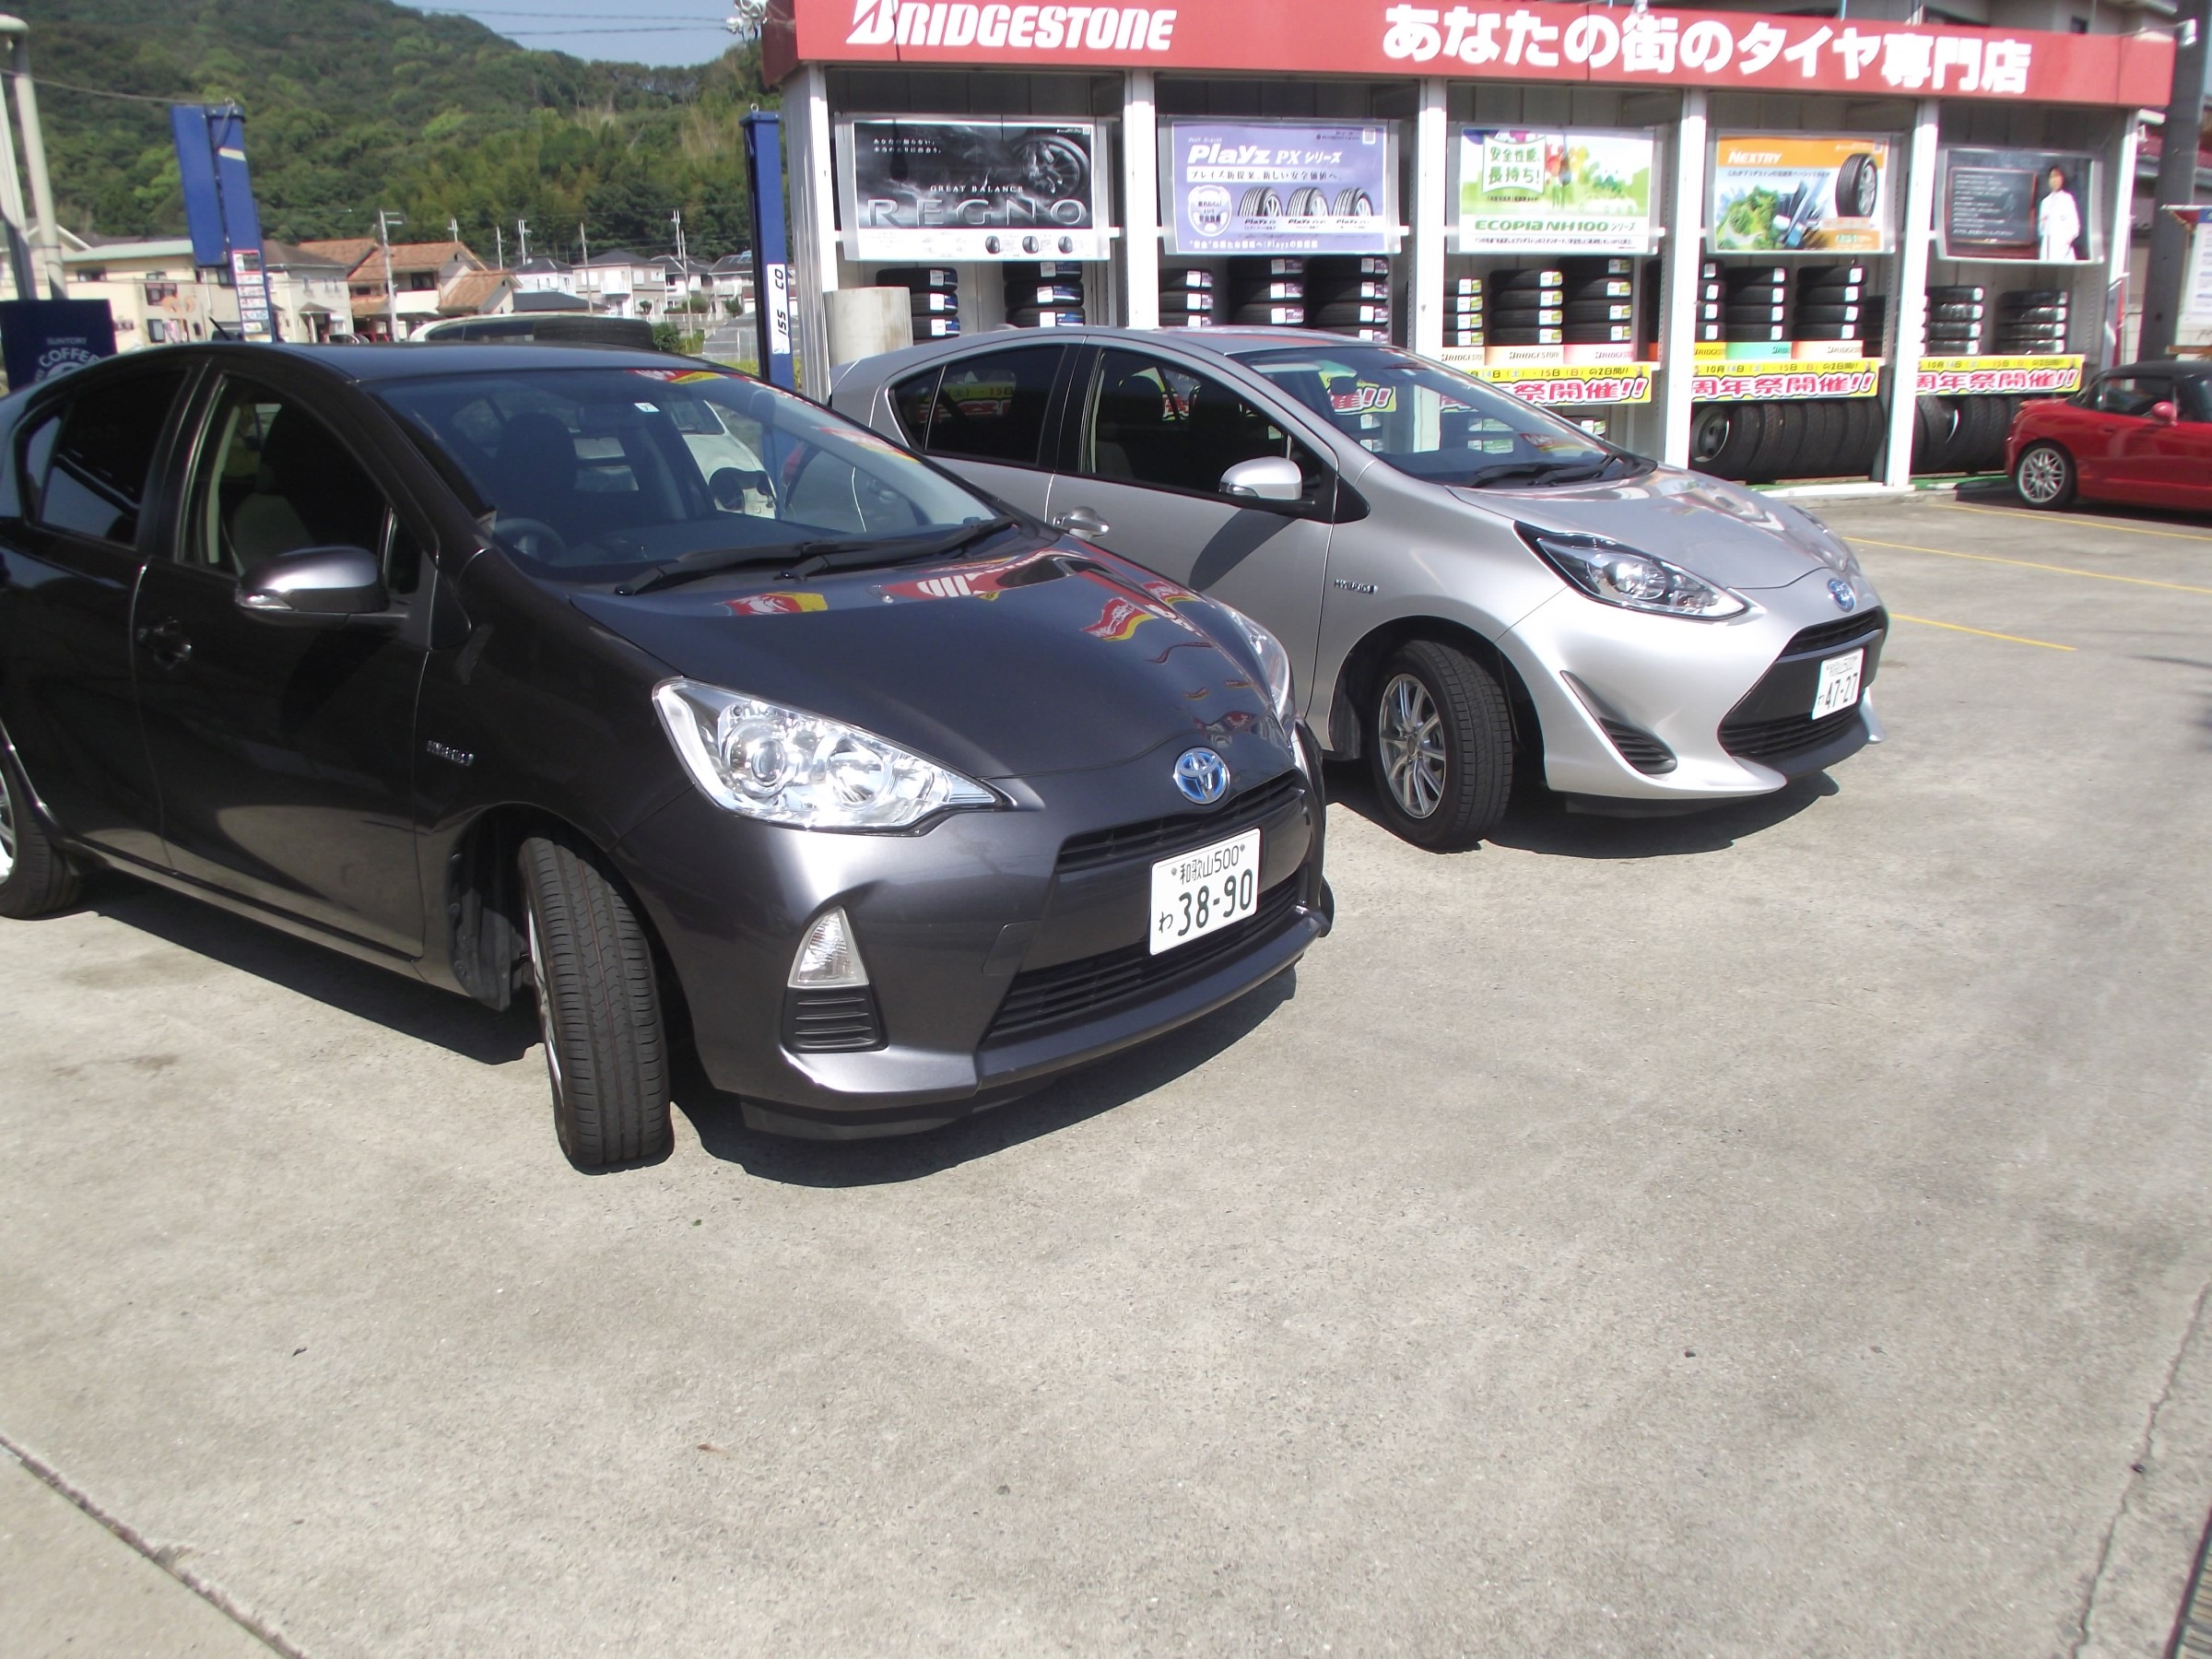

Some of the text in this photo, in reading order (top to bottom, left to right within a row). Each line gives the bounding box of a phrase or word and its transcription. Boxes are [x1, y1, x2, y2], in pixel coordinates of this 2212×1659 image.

[845, 0, 1177, 51] BRIDGESTONE
[1382, 3, 2032, 95] あなたの街のタイヤ専門店
[1276, 150, 1303, 166] PX
[1304, 151, 1343, 164] シリーズ
[1727, 151, 1783, 164] NEXTRY
[1488, 165, 1540, 185] 長持ち!
[930, 184, 1024, 193] GREAT BALANCE
[867, 198, 1087, 228] REGNO
[1546, 220, 1609, 232] NH100
[1611, 222, 1637, 232] シリーズ
[774, 267, 784, 290] CO
[1158, 868, 1253, 936] わ 38-90
